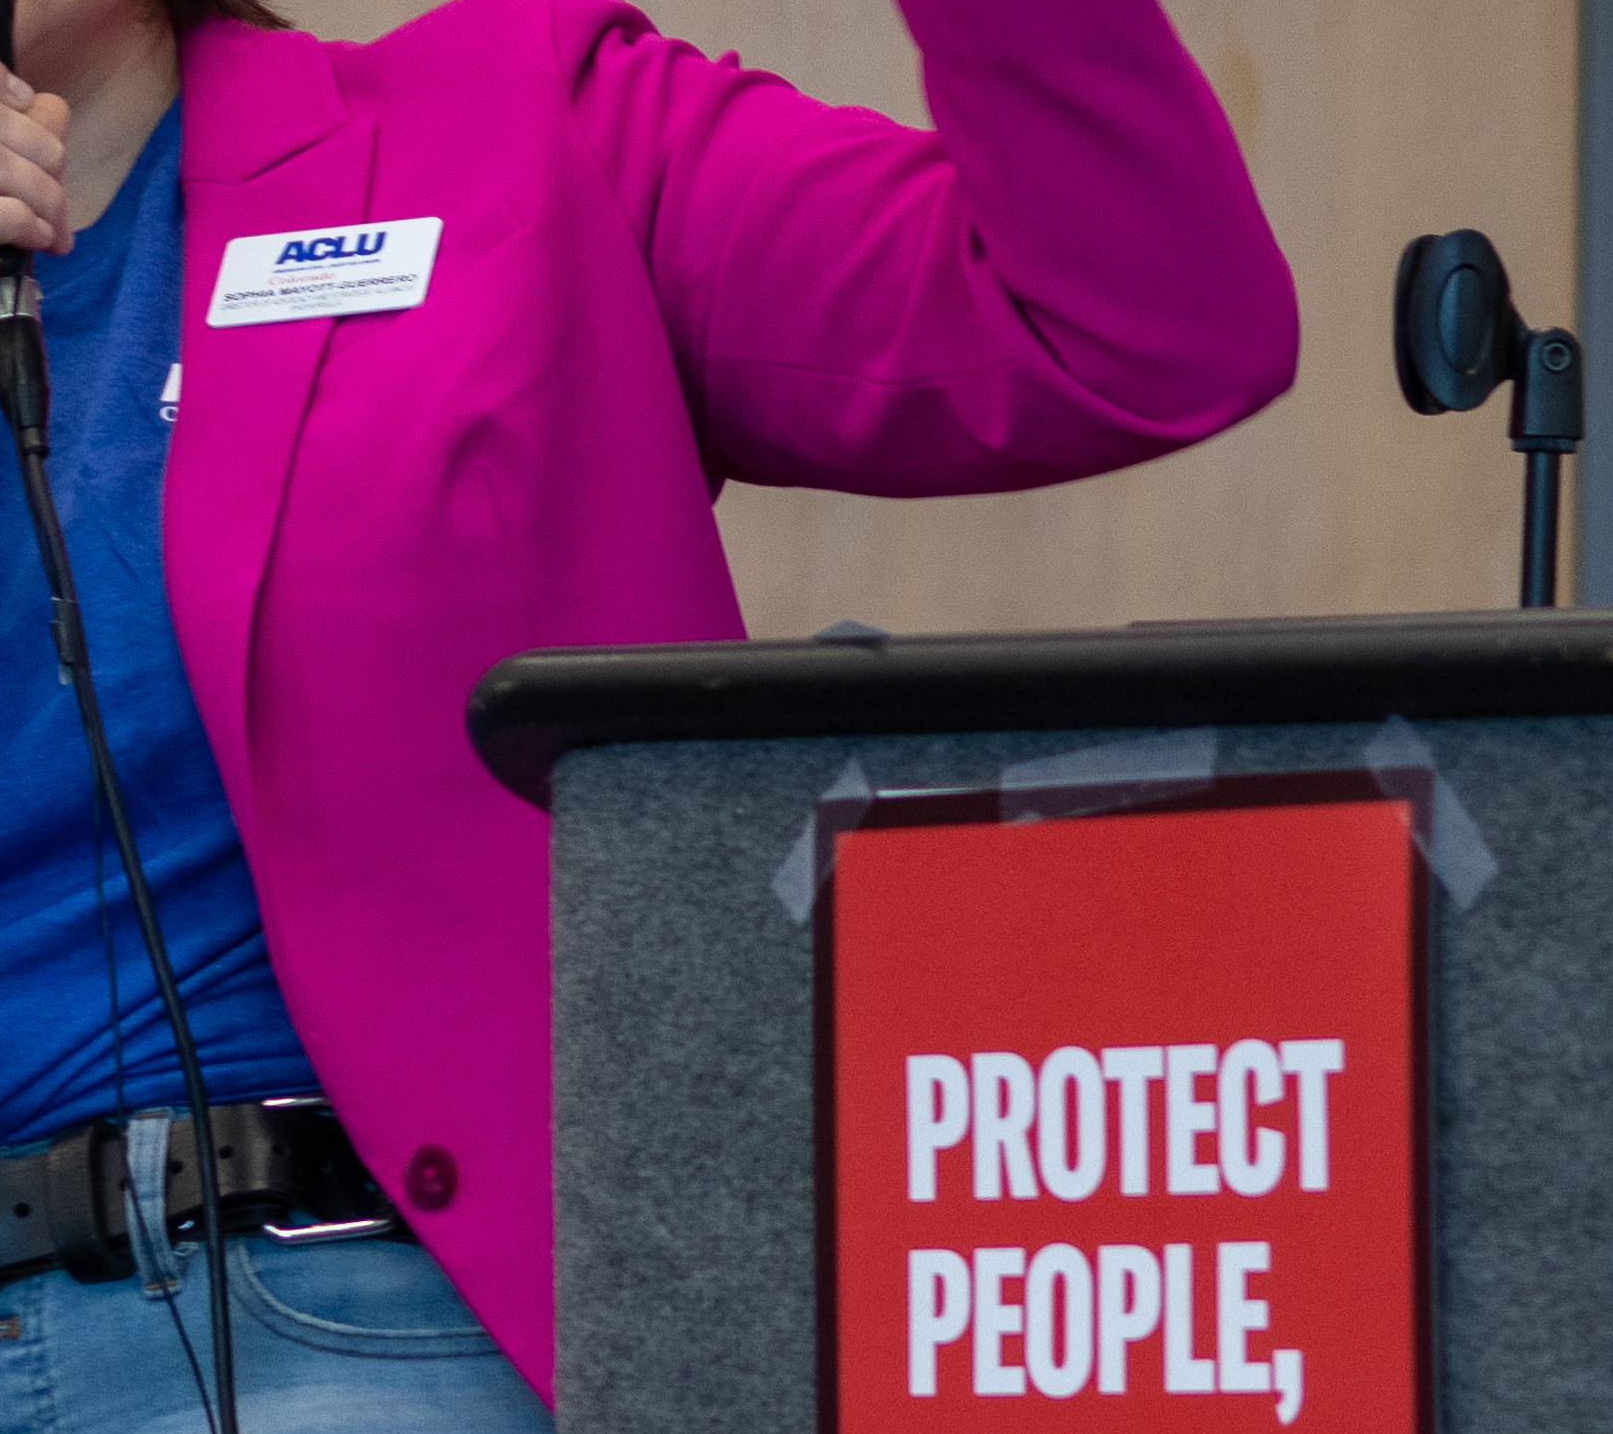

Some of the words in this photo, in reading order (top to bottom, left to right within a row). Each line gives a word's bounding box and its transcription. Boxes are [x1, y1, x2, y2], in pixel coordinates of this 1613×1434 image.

[275, 231, 387, 265] ACLU
[906, 1038, 1344, 1202] PROTECT
[908, 1241, 1303, 1425] PEOPLE,
